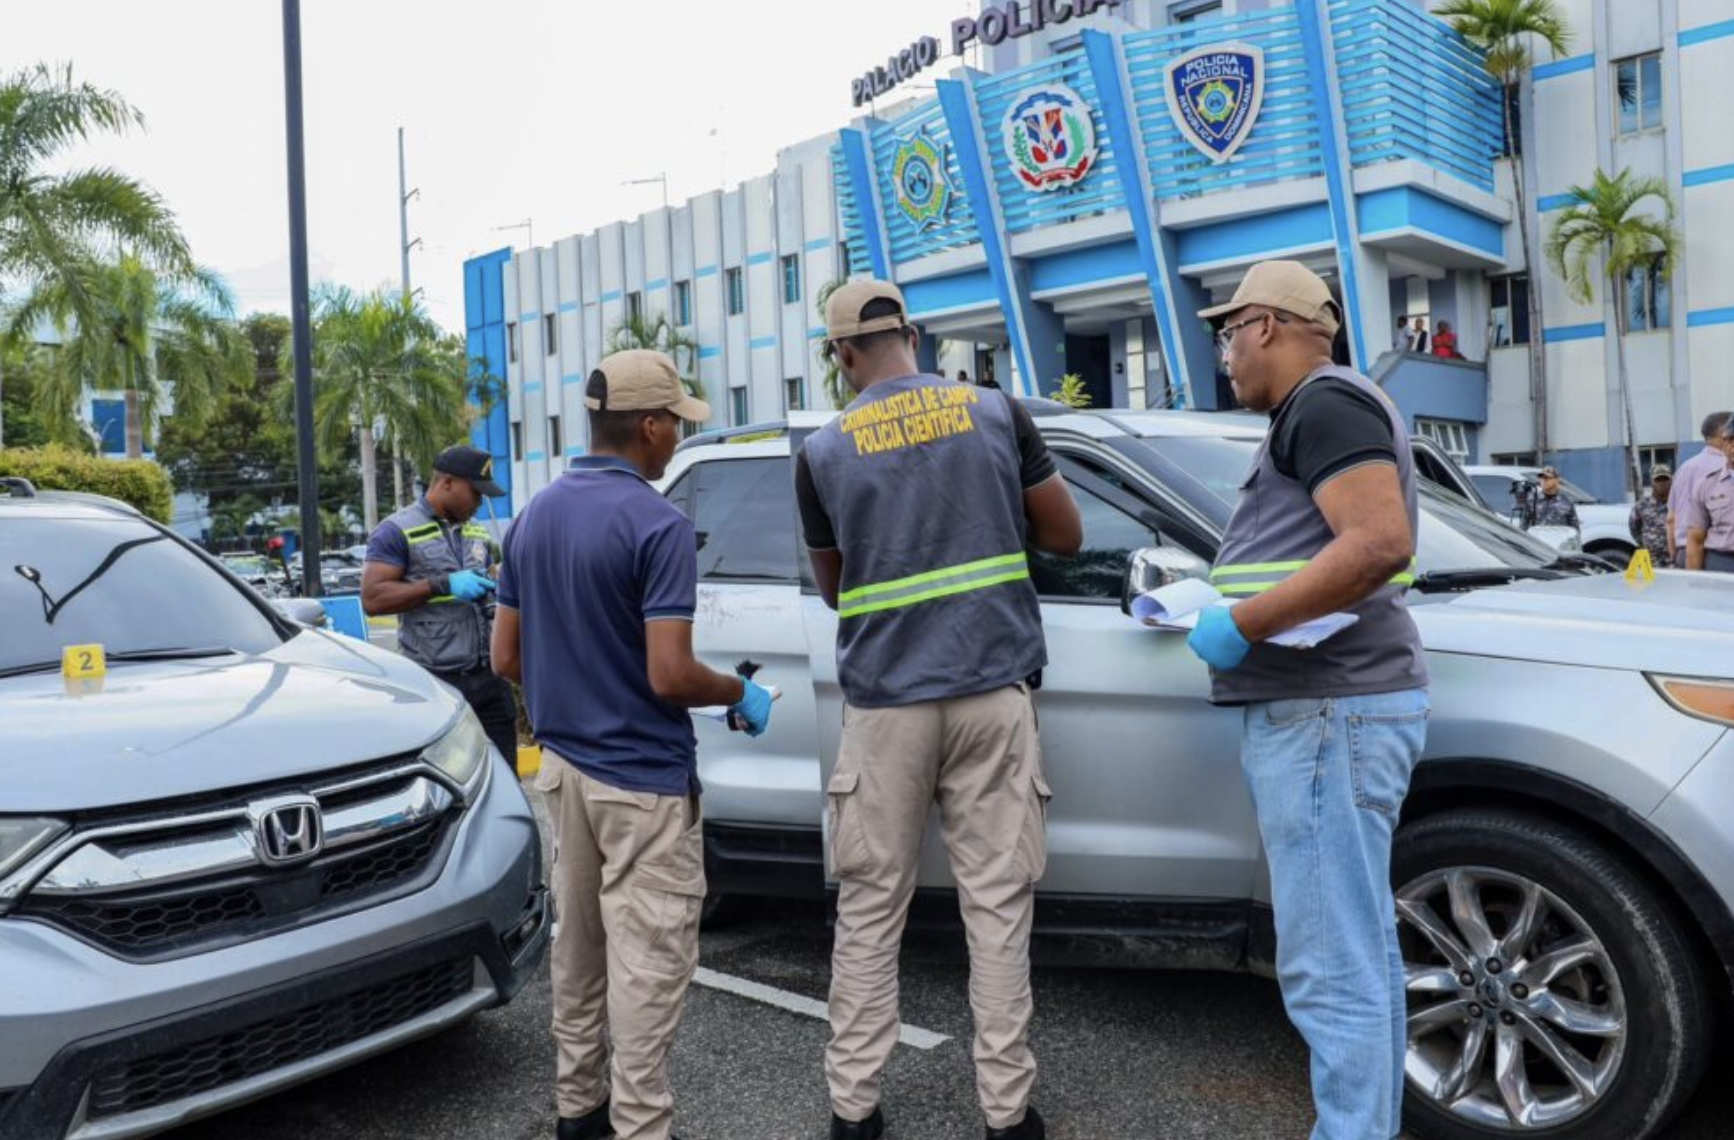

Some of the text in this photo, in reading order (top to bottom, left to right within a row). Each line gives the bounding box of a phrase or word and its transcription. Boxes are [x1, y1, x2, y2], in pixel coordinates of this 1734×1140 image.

[851, 0, 1121, 107] PALACIO POLIC
[1185, 54, 1239, 74] POLICIA
[1181, 66, 1249, 88] NACIONAL
[921, 386, 940, 411] DE
[852, 404, 975, 457] POLICIA CIENTIFICA
[78, 650, 95, 672] 2
